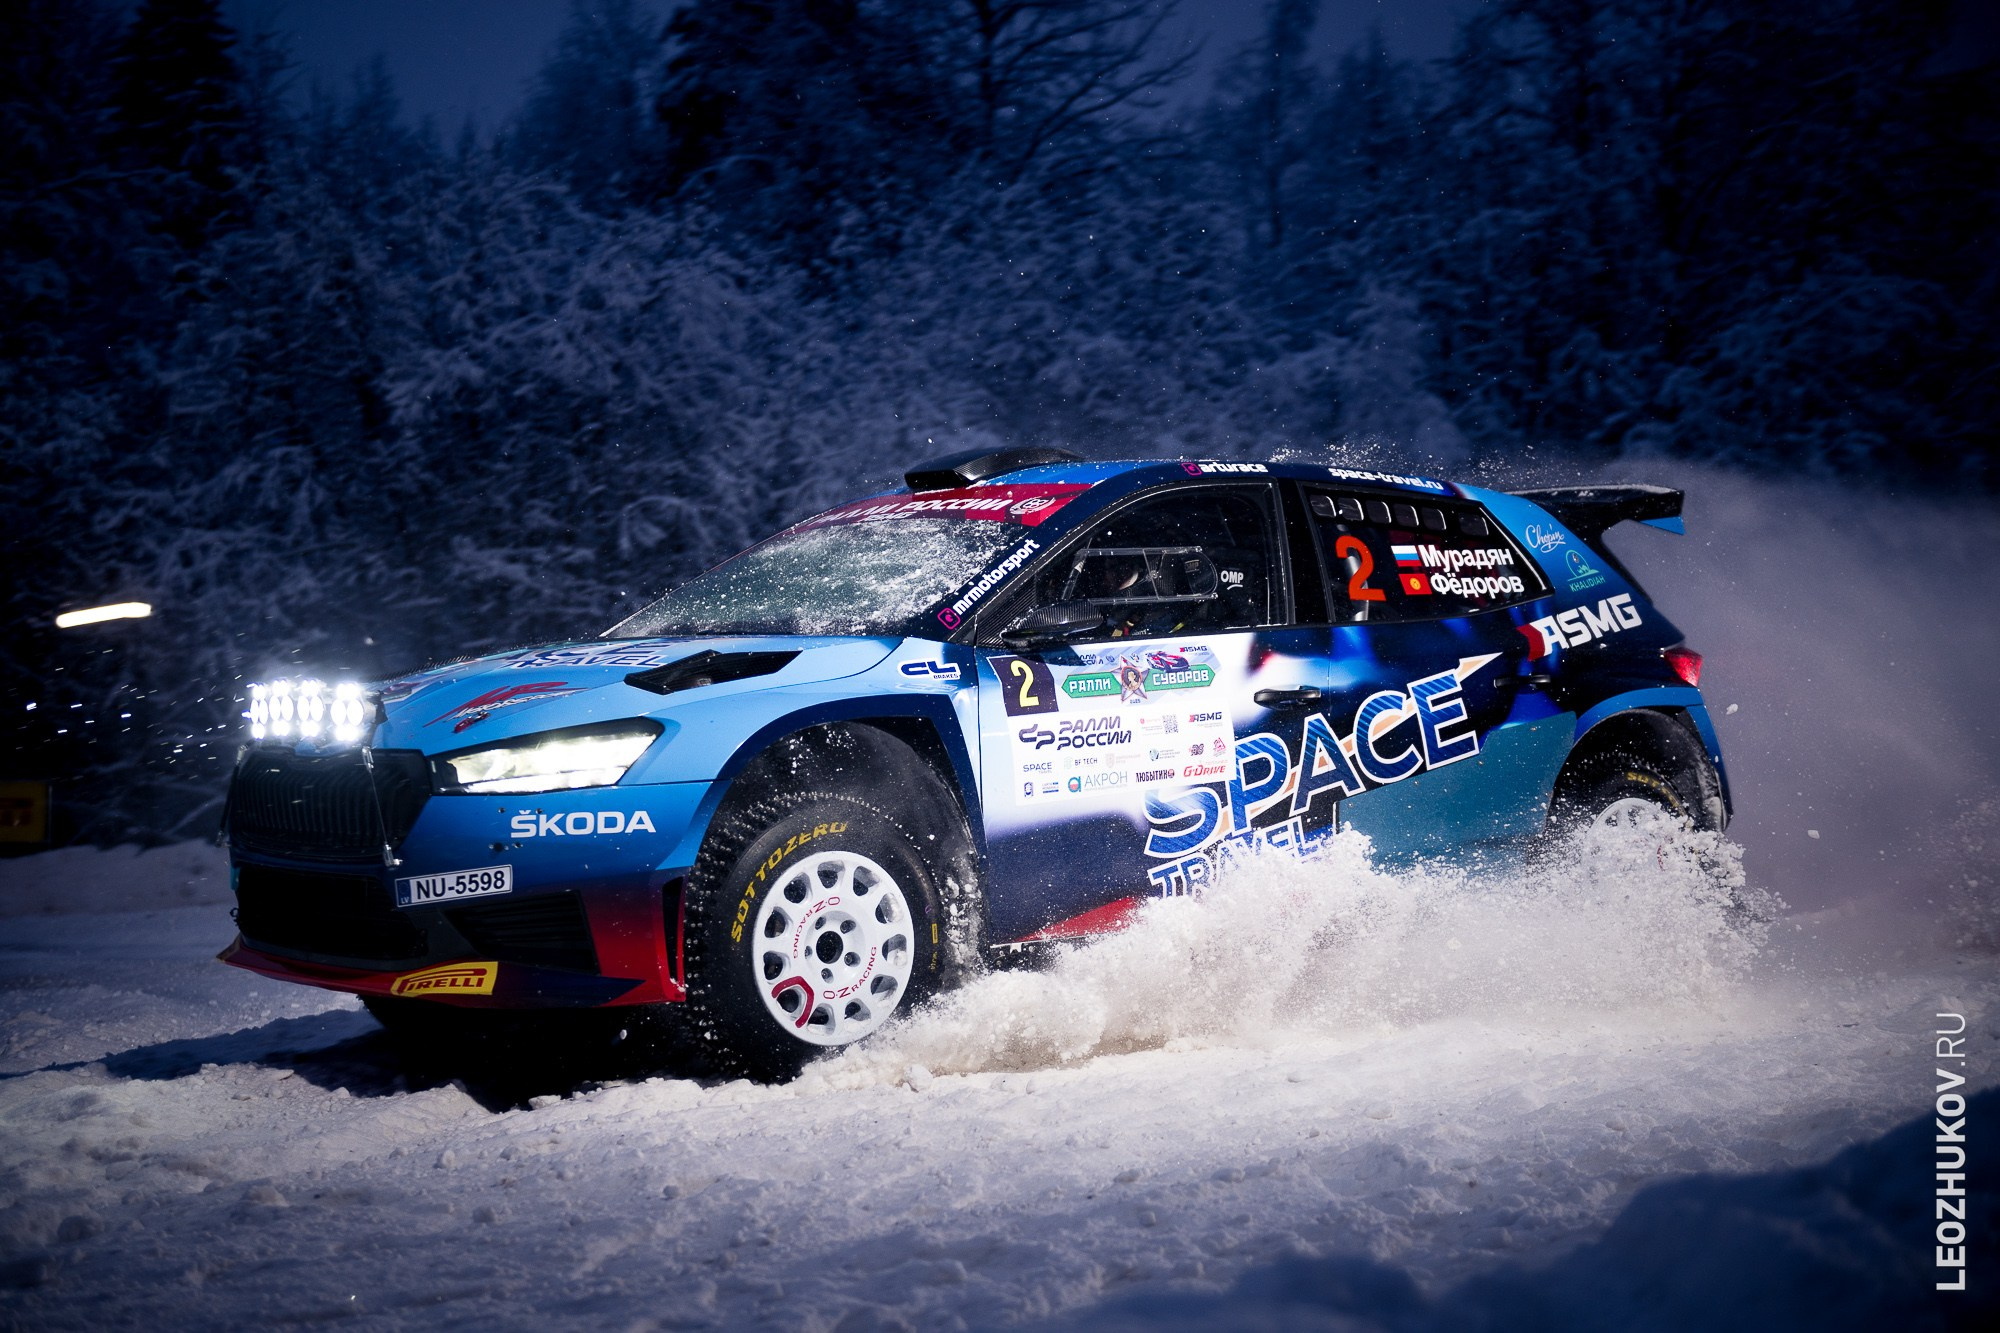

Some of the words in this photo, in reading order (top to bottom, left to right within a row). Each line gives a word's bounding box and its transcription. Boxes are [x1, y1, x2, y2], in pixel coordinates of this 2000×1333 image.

[1201, 462, 1268, 473] arturace
[1328, 467, 1444, 491] space-travel.ru
[1335, 535, 1386, 601] 2
[1418, 545, 1514, 572] Мурадян
[953, 538, 1040, 615] mrmotorsport
[1221, 570, 1243, 584] OMP
[1431, 572, 1524, 599] Фёдоров
[1570, 576, 1606, 592] KHALIDIAH
[1528, 593, 1643, 656] ASMG
[1010, 660, 1040, 708] 2
[1069, 676, 1111, 693] РАЛЛИ
[1153, 670, 1209, 686] СУВОРОВ
[1059, 716, 1121, 735] РАЛЛИ
[1194, 711, 1223, 722] ASMG
[1057, 730, 1132, 751] РОССИИ
[1023, 762, 1053, 773] SPACE
[1144, 668, 1480, 858] SPACE
[1084, 771, 1128, 787] АКРОН
[510, 809, 657, 838] ŠKODA
[416, 870, 506, 899] NU-5598
[731, 821, 849, 943] SOTTOZERO
[400, 896, 411, 904] LV
[396, 968, 488, 993] PIRELLI
[851, 946, 877, 992] RACING
